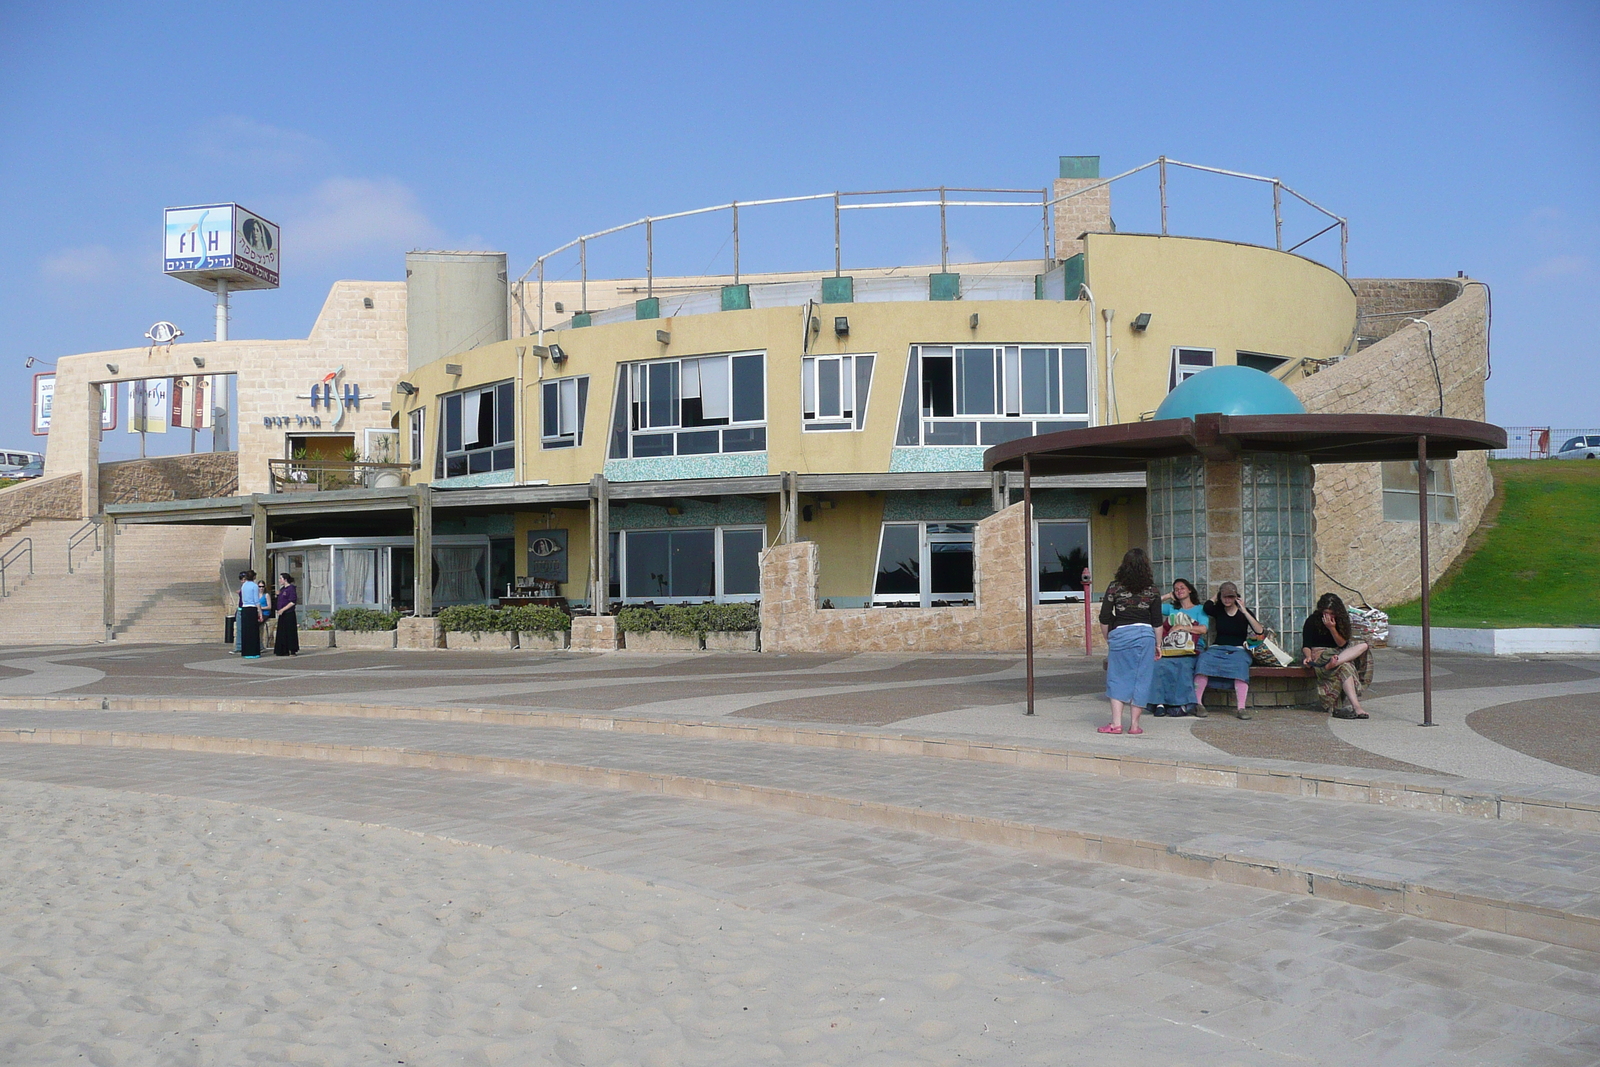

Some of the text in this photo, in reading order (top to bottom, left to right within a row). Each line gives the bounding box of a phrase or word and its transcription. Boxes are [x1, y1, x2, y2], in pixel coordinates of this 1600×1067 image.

[166, 257, 231, 270] גריל דגים
[263, 414, 321, 427] גריל דגים
